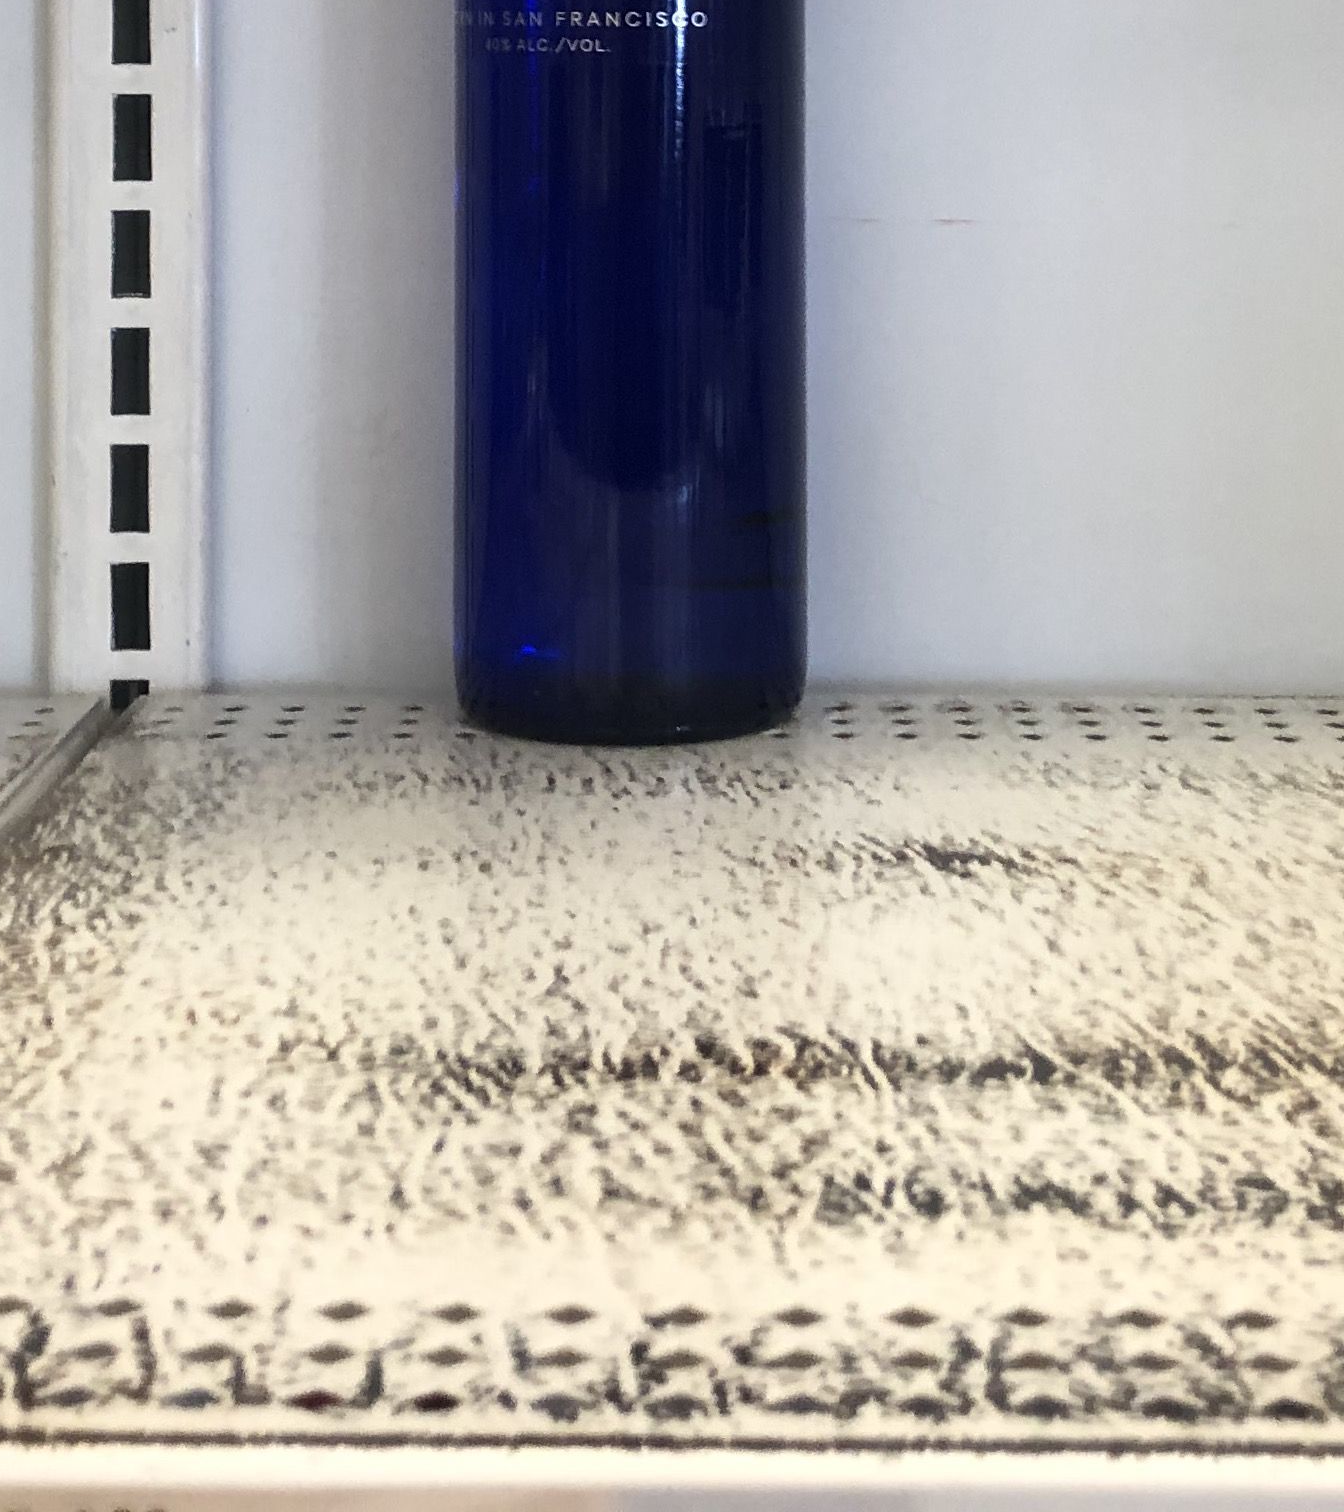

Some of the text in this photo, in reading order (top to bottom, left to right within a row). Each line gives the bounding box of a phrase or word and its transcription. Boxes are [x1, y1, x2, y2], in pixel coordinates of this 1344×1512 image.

[477, 10, 495, 28] IN
[502, 10, 544, 28] SAN
[555, 10, 709, 29] FRANCISCO
